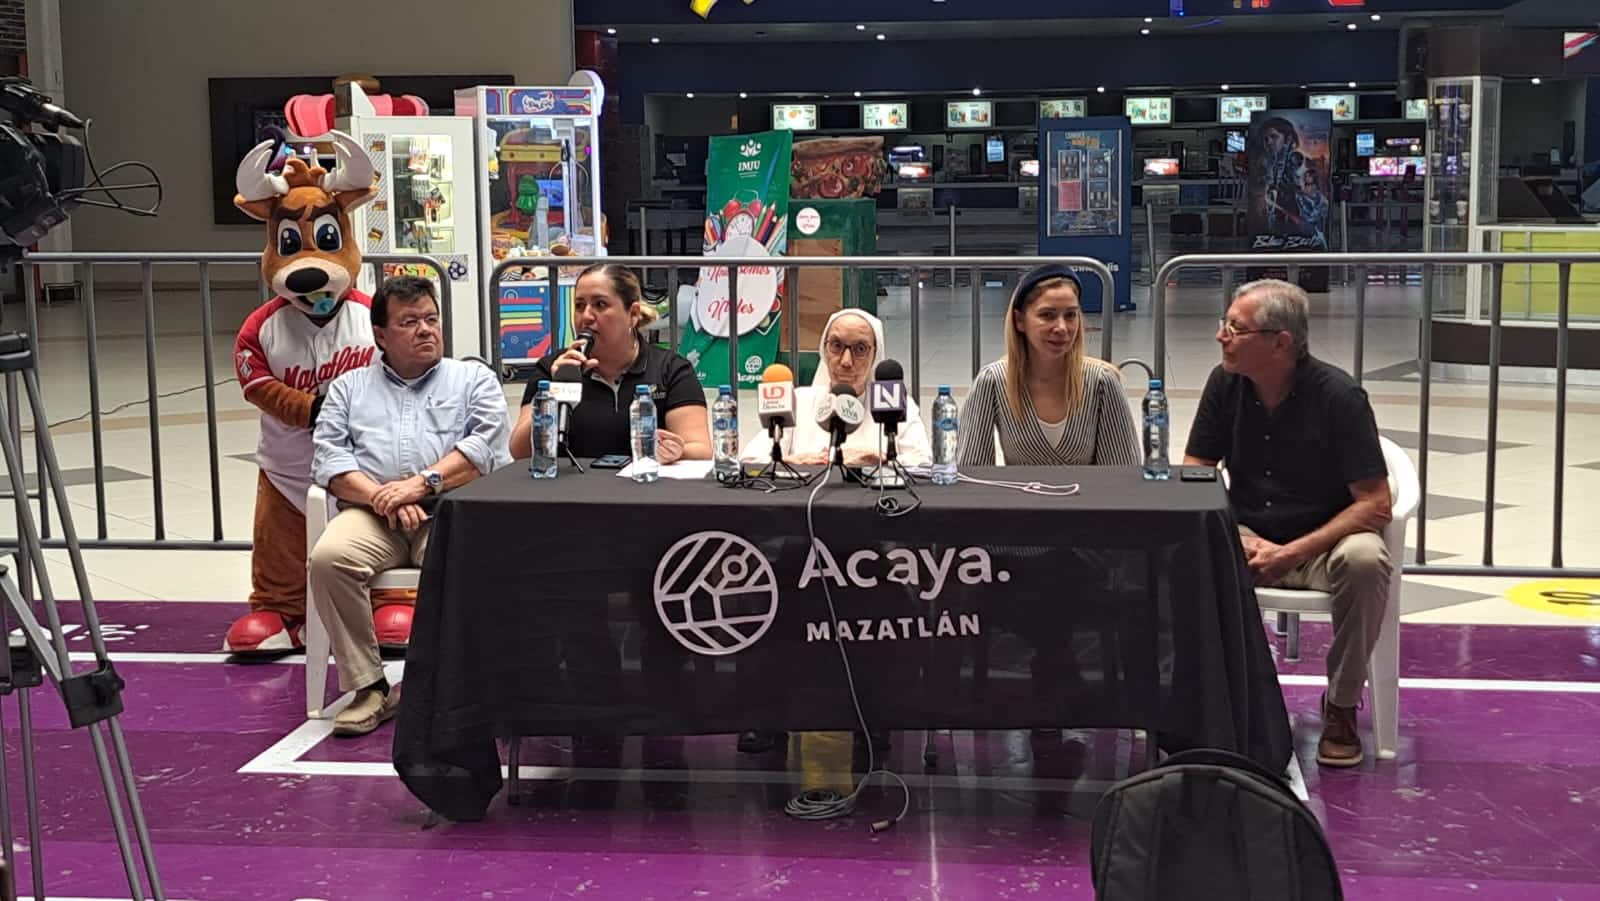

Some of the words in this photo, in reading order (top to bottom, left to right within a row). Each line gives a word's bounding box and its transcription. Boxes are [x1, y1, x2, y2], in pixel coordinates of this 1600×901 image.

[738, 160, 761, 172] IMJU
[798, 537, 1011, 600] Acaya.
[807, 611, 981, 642] MAZATLÁN
